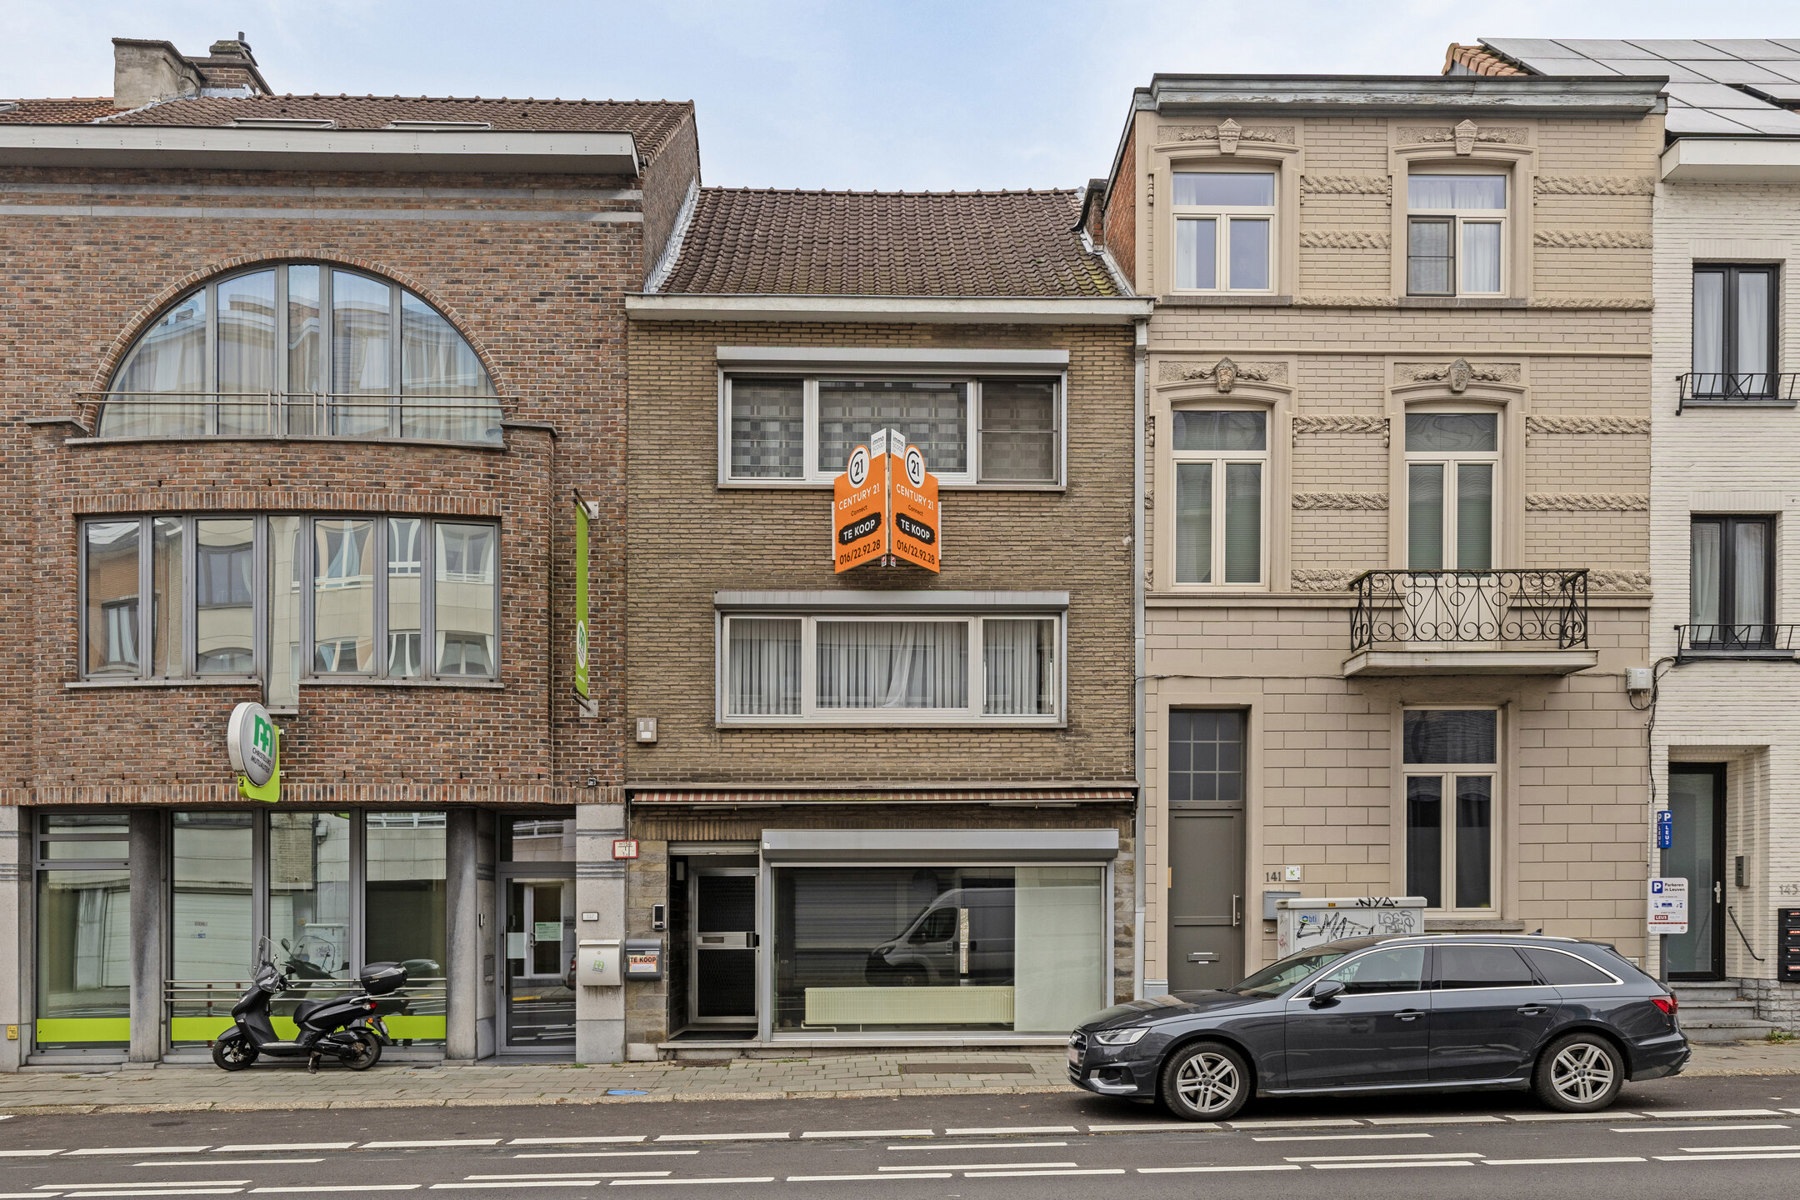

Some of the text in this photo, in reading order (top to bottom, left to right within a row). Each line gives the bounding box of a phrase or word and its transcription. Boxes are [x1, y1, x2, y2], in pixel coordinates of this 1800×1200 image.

[838, 483, 880, 510] CENTURY 21
[896, 483, 934, 511] CENTURY 21
[850, 505, 868, 517] Connect
[908, 504, 924, 516] Connect
[843, 519, 876, 541] TE KOOP
[900, 519, 931, 540] TE KOOP
[840, 539, 881, 565] 016/22.92.28
[896, 539, 935, 565] 016/22.92.28
[1664, 812, 1671, 821] P
[1265, 871, 1281, 882] 141
[1653, 882, 1662, 892] P
